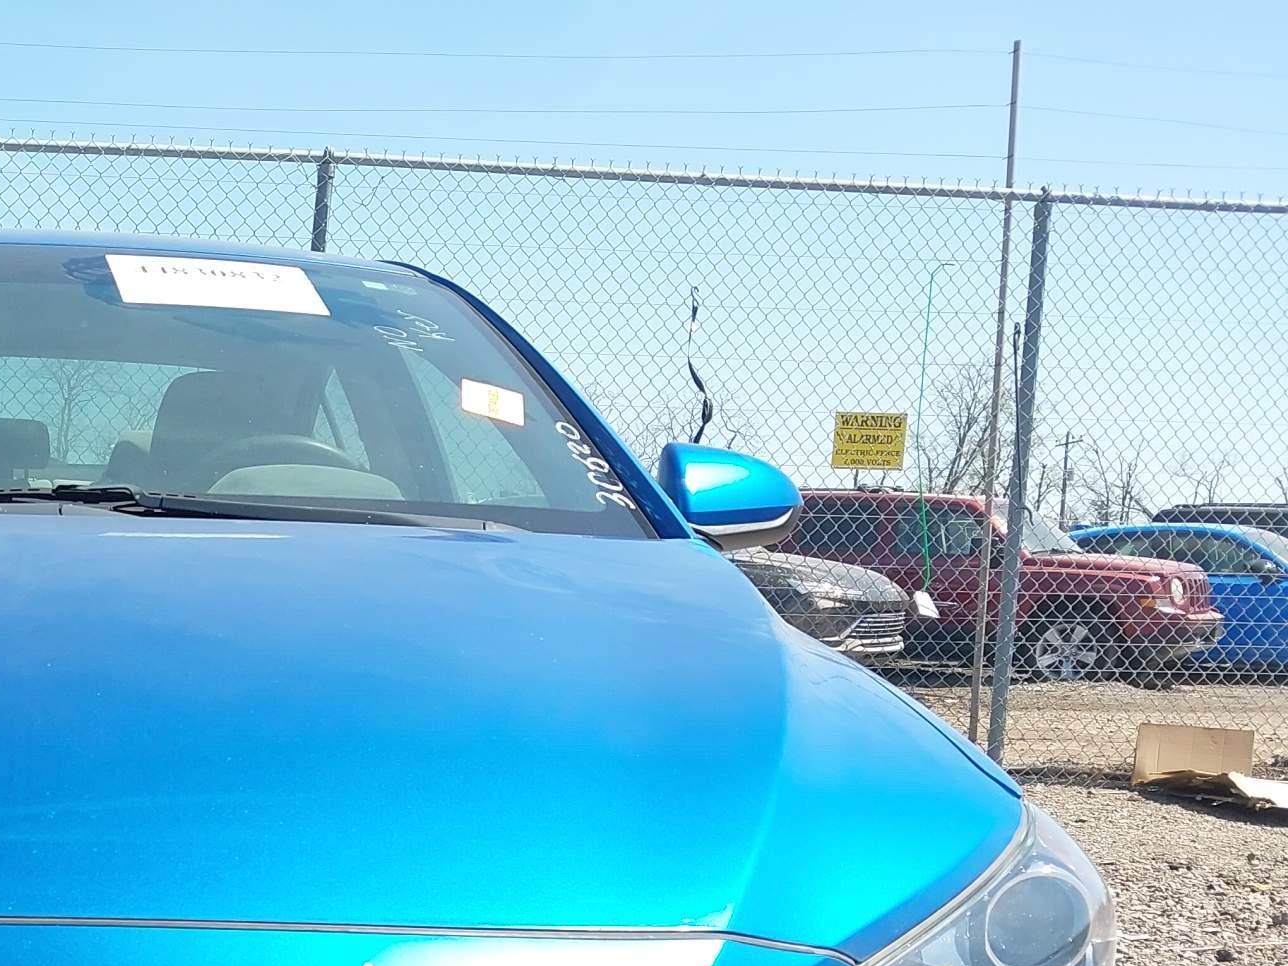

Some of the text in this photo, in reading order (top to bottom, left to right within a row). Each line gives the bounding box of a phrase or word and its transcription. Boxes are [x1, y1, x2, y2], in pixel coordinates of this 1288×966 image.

[840, 414, 902, 428] WARNING
[845, 433, 893, 445] ALARMED
[835, 448, 873, 457] ELECTRIC
[866, 458, 892, 466] VOLTS
